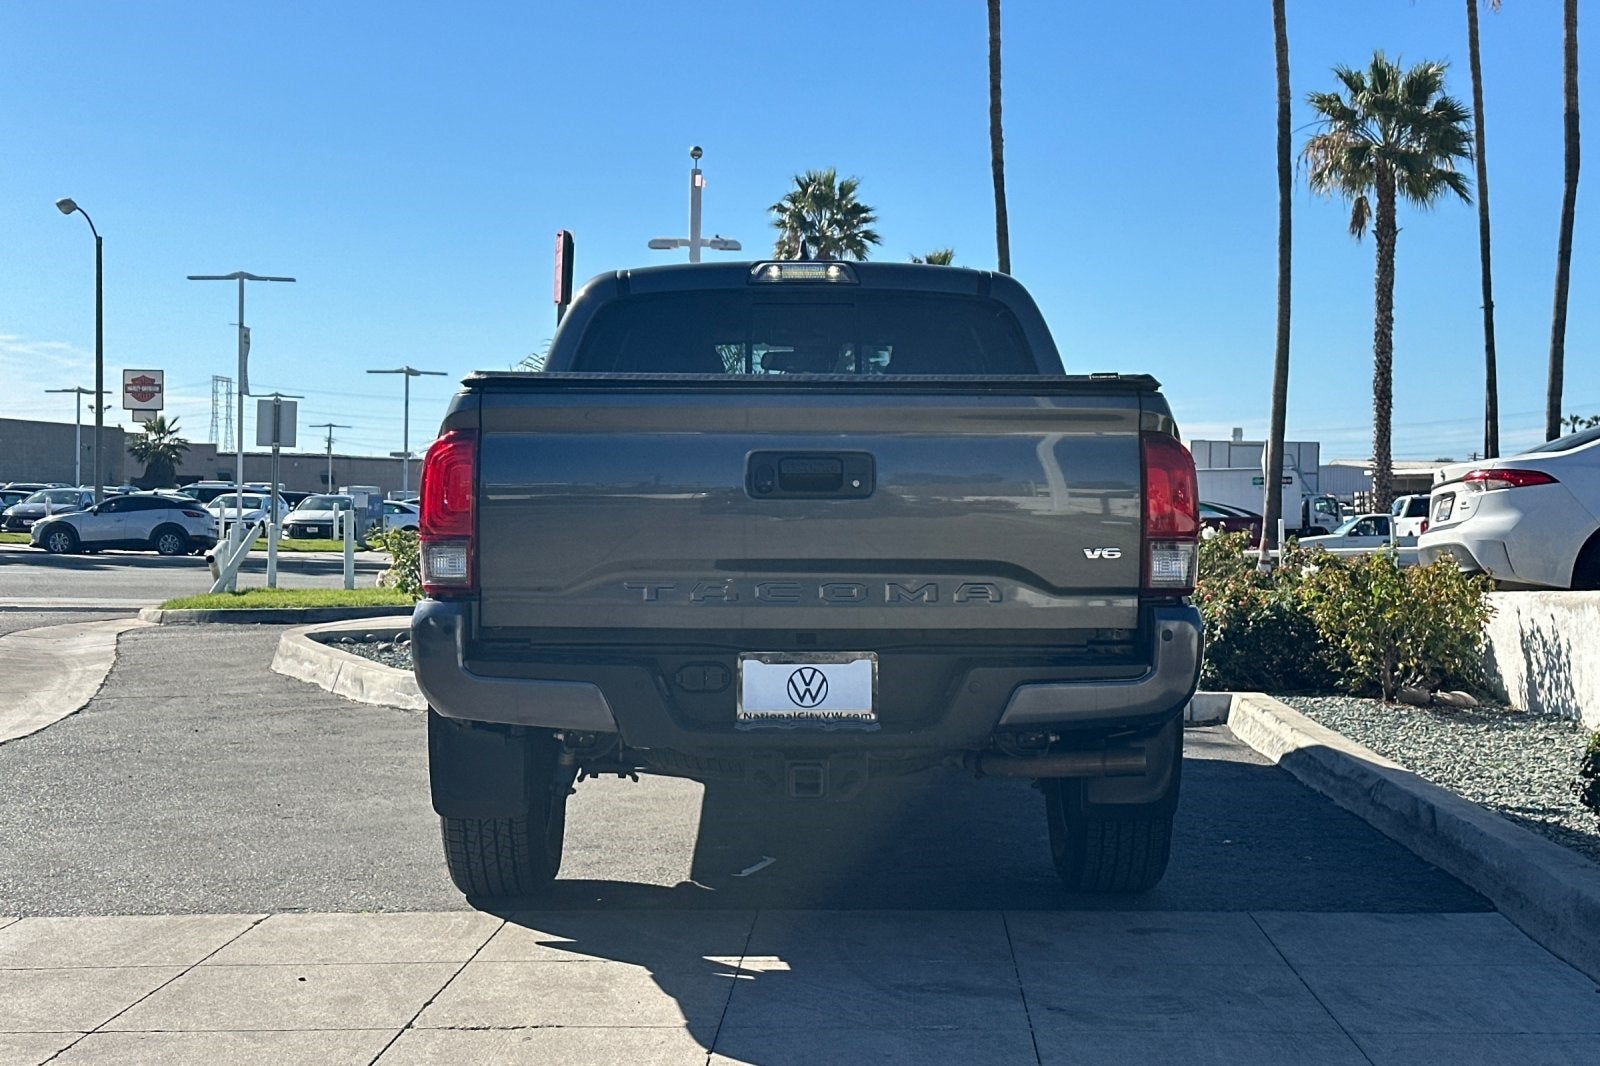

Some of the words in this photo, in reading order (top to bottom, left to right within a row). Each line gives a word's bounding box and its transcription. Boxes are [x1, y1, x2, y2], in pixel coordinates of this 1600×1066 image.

[1083, 547, 1122, 559] V6
[623, 579, 1004, 604] TACOMA
[743, 711, 872, 720] NationalCityVW.com
